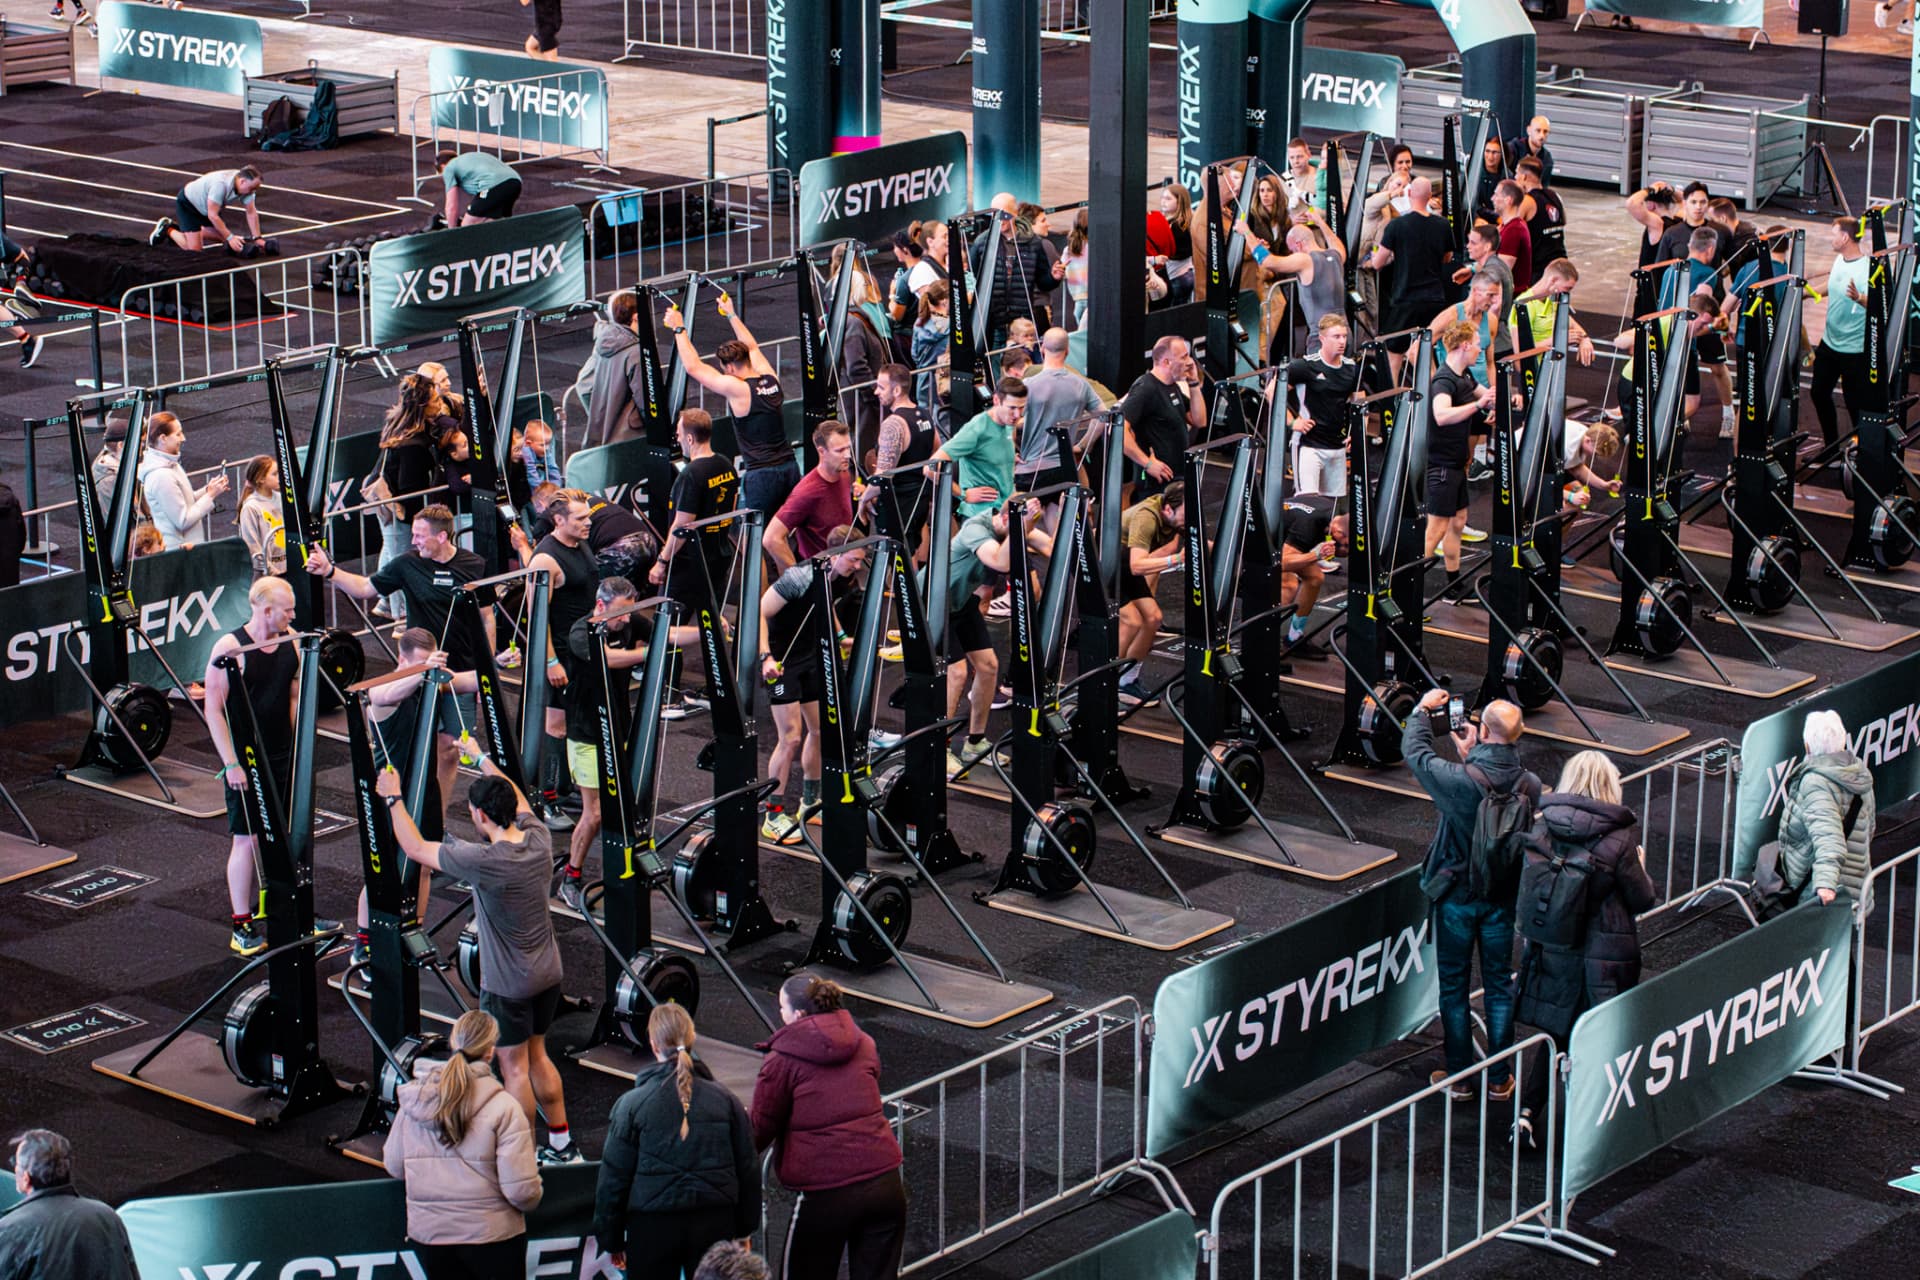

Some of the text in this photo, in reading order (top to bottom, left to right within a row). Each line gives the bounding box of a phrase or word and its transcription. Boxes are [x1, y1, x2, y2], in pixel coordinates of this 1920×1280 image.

[138, 30, 247, 70] STYREKX
[768, 0, 787, 125] STYREK
[472, 78, 591, 120] STYREKX
[972, 86, 1003, 102] YREKX
[1178, 39, 1201, 194] STYREKX
[1303, 72, 1387, 110] YREKX
[844, 162, 955, 217] STYREKX
[427, 240, 567, 303] STYREKX
[1210, 222, 1219, 271] concept 2
[953, 279, 962, 330] concept 2
[1748, 352, 1755, 360] 2
[1870, 326, 1878, 368] concept
[645, 357, 655, 405] concept
[1637, 387, 1643, 395] 2
[469, 396, 480, 445] concept
[277, 438, 289, 486] concept
[1499, 431, 1511, 488] concept 2
[79, 475, 94, 535] concept 2
[1354, 475, 1364, 535] concept 2
[1190, 527, 1202, 588] concept 2
[899, 574, 916, 640] concept 2
[1014, 579, 1027, 644] concept 2
[706, 629, 725, 697] concept 2
[821, 638, 835, 705] concept 2
[485, 696, 507, 767] concept 2
[598, 706, 615, 775] concept 2
[1846, 703, 1920, 768] YREK
[251, 768, 274, 843] concept 2
[359, 779, 378, 852] concept 2
[83, 877, 118, 891] DUO
[1235, 918, 1429, 1062] STYREKX
[1646, 948, 1831, 1097] STYREKX
